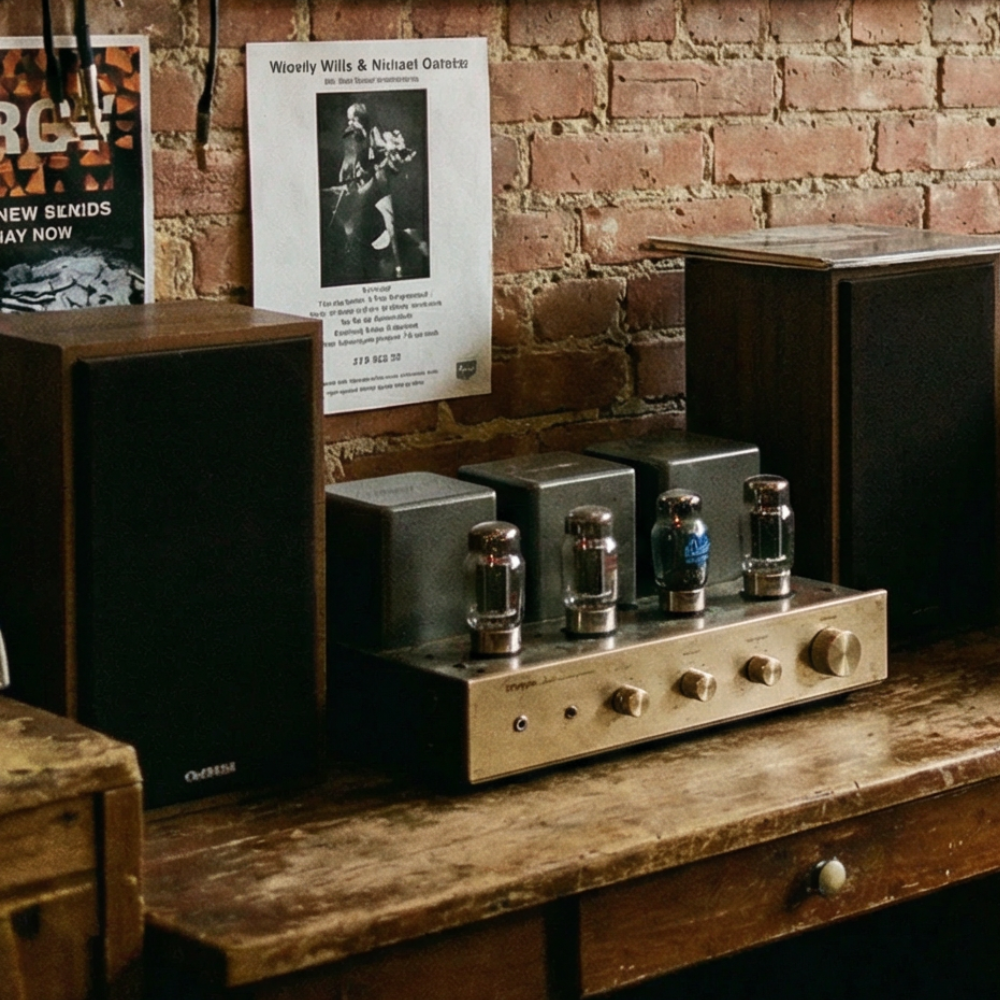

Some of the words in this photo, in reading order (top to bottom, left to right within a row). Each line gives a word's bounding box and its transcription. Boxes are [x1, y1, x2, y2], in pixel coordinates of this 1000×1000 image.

[357, 58, 367, 72] &
[0, 206, 38, 222] NEW
[0, 228, 27, 244] AY
[33, 226, 72, 242] NOW
